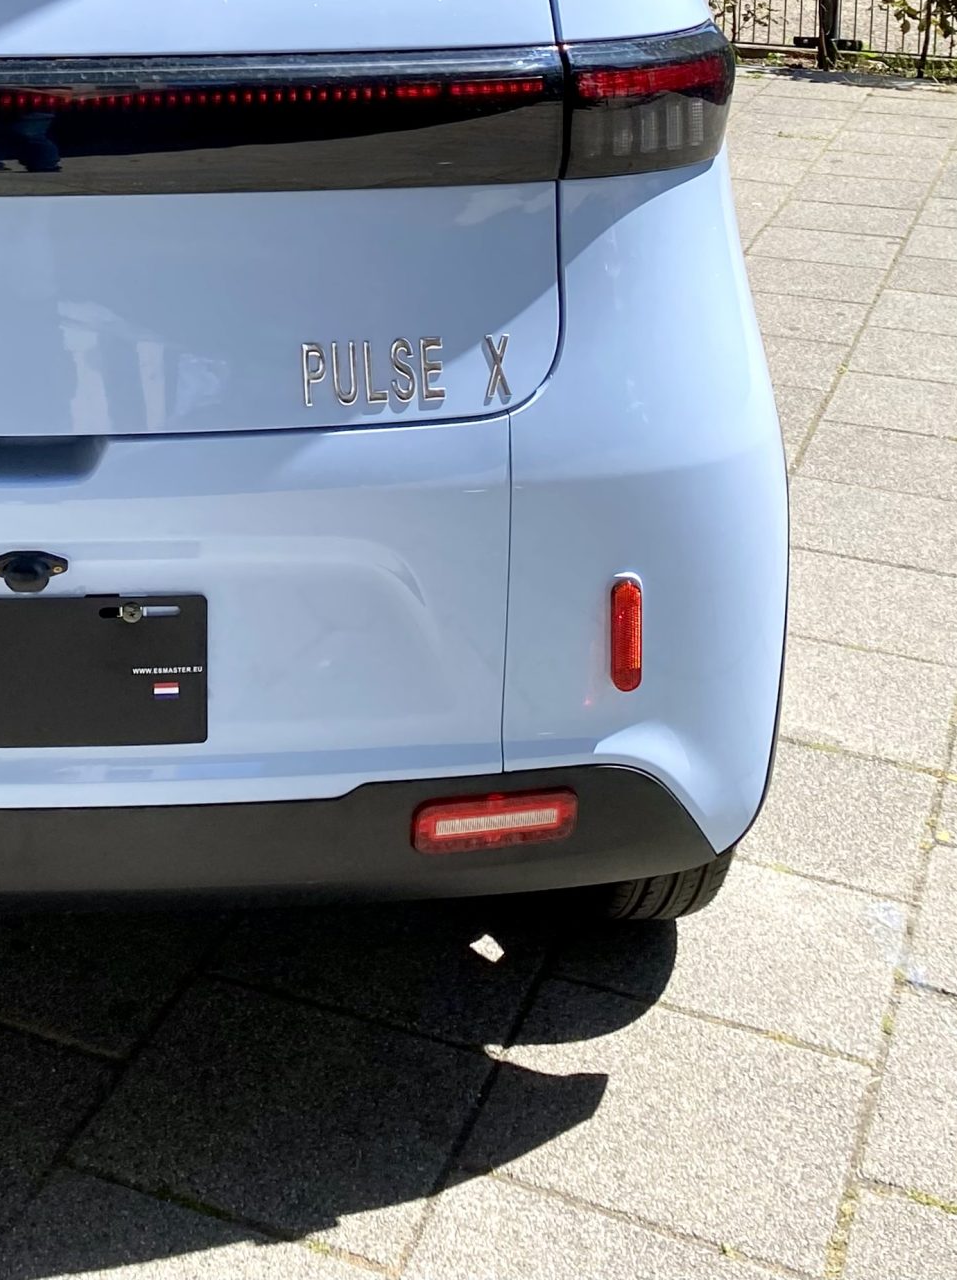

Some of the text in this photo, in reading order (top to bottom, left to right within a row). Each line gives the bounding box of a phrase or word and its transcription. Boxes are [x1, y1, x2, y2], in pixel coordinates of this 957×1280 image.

[302, 333, 513, 406] PULSE X
[132, 666, 203, 675] WWW.ESMASTER.EU
